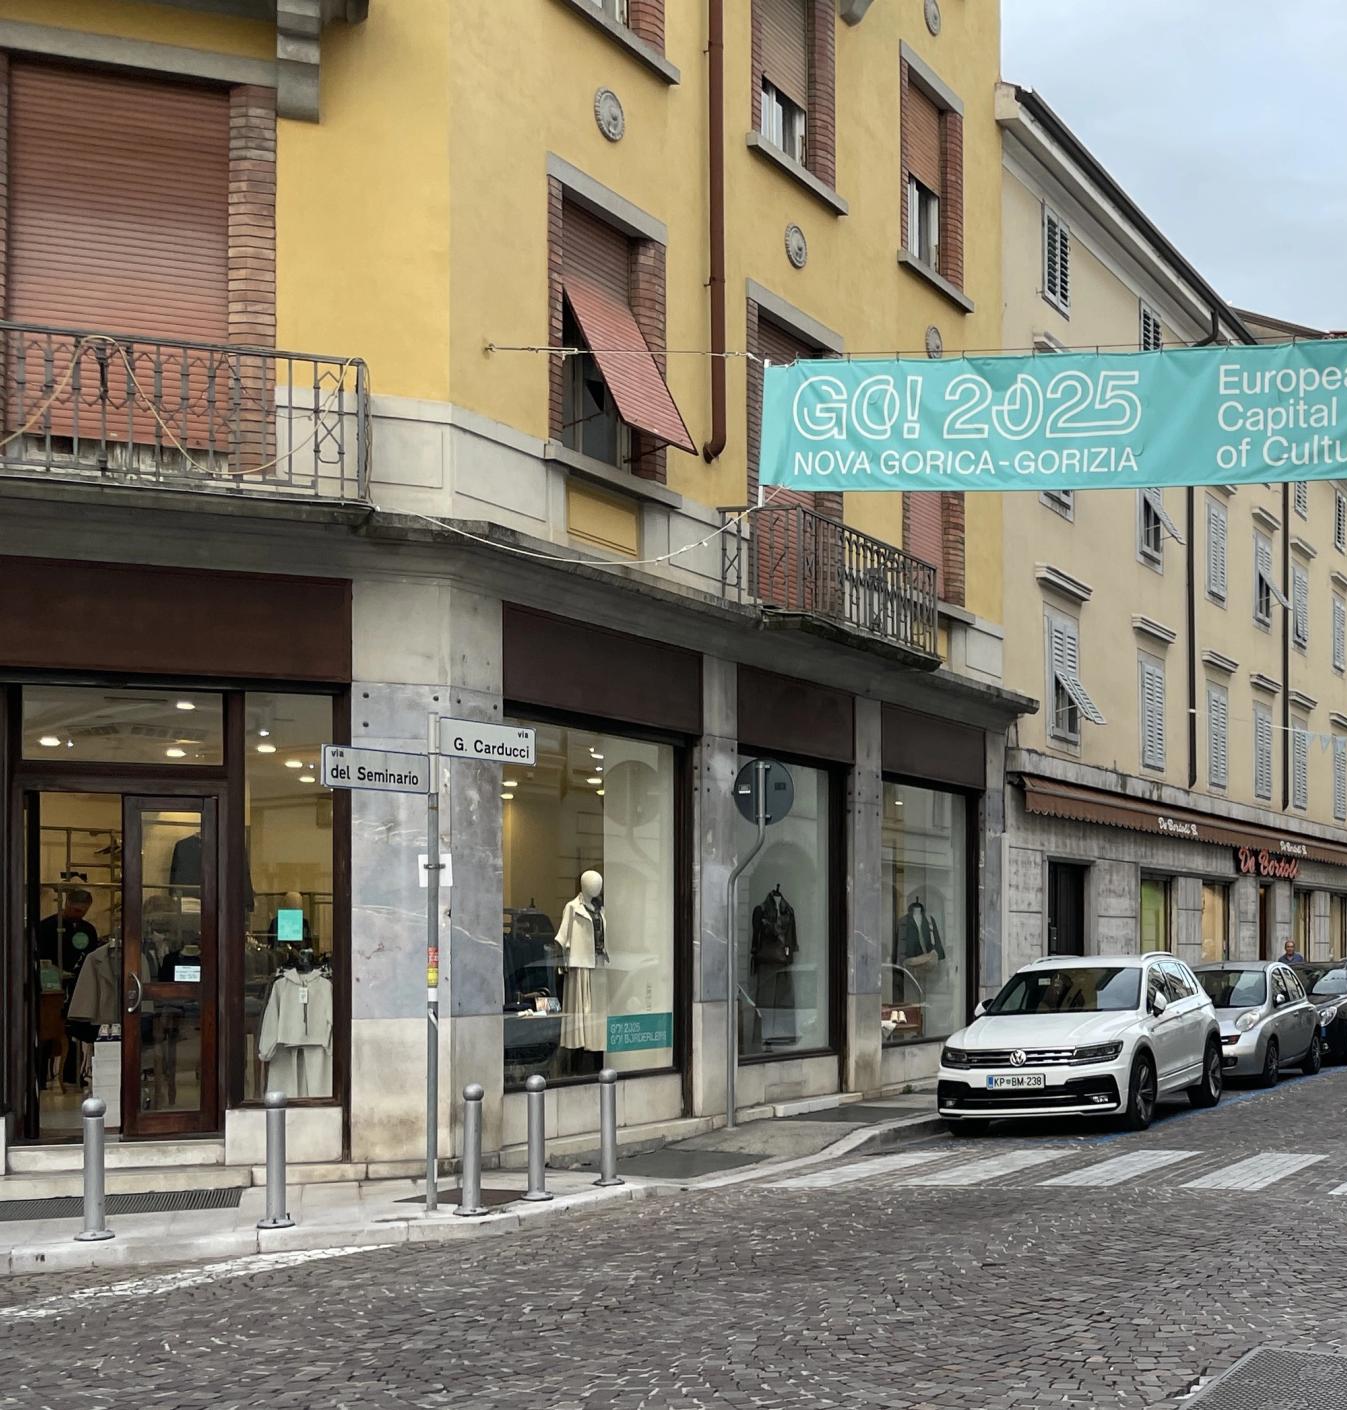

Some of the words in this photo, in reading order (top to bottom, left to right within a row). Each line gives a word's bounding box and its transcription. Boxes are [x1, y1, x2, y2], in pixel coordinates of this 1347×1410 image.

[792, 374, 923, 441] GO!
[943, 370, 1142, 441] 2025
[1217, 396, 1338, 436] Capital
[794, 451, 872, 476] NOVA
[1216, 439, 1251, 470] of
[517, 730, 529, 739] via
[331, 749, 344, 758] via
[453, 738, 468, 752] G.
[474, 740, 530, 759] Carducci
[330, 765, 351, 780] del
[357, 766, 419, 786] Seminario
